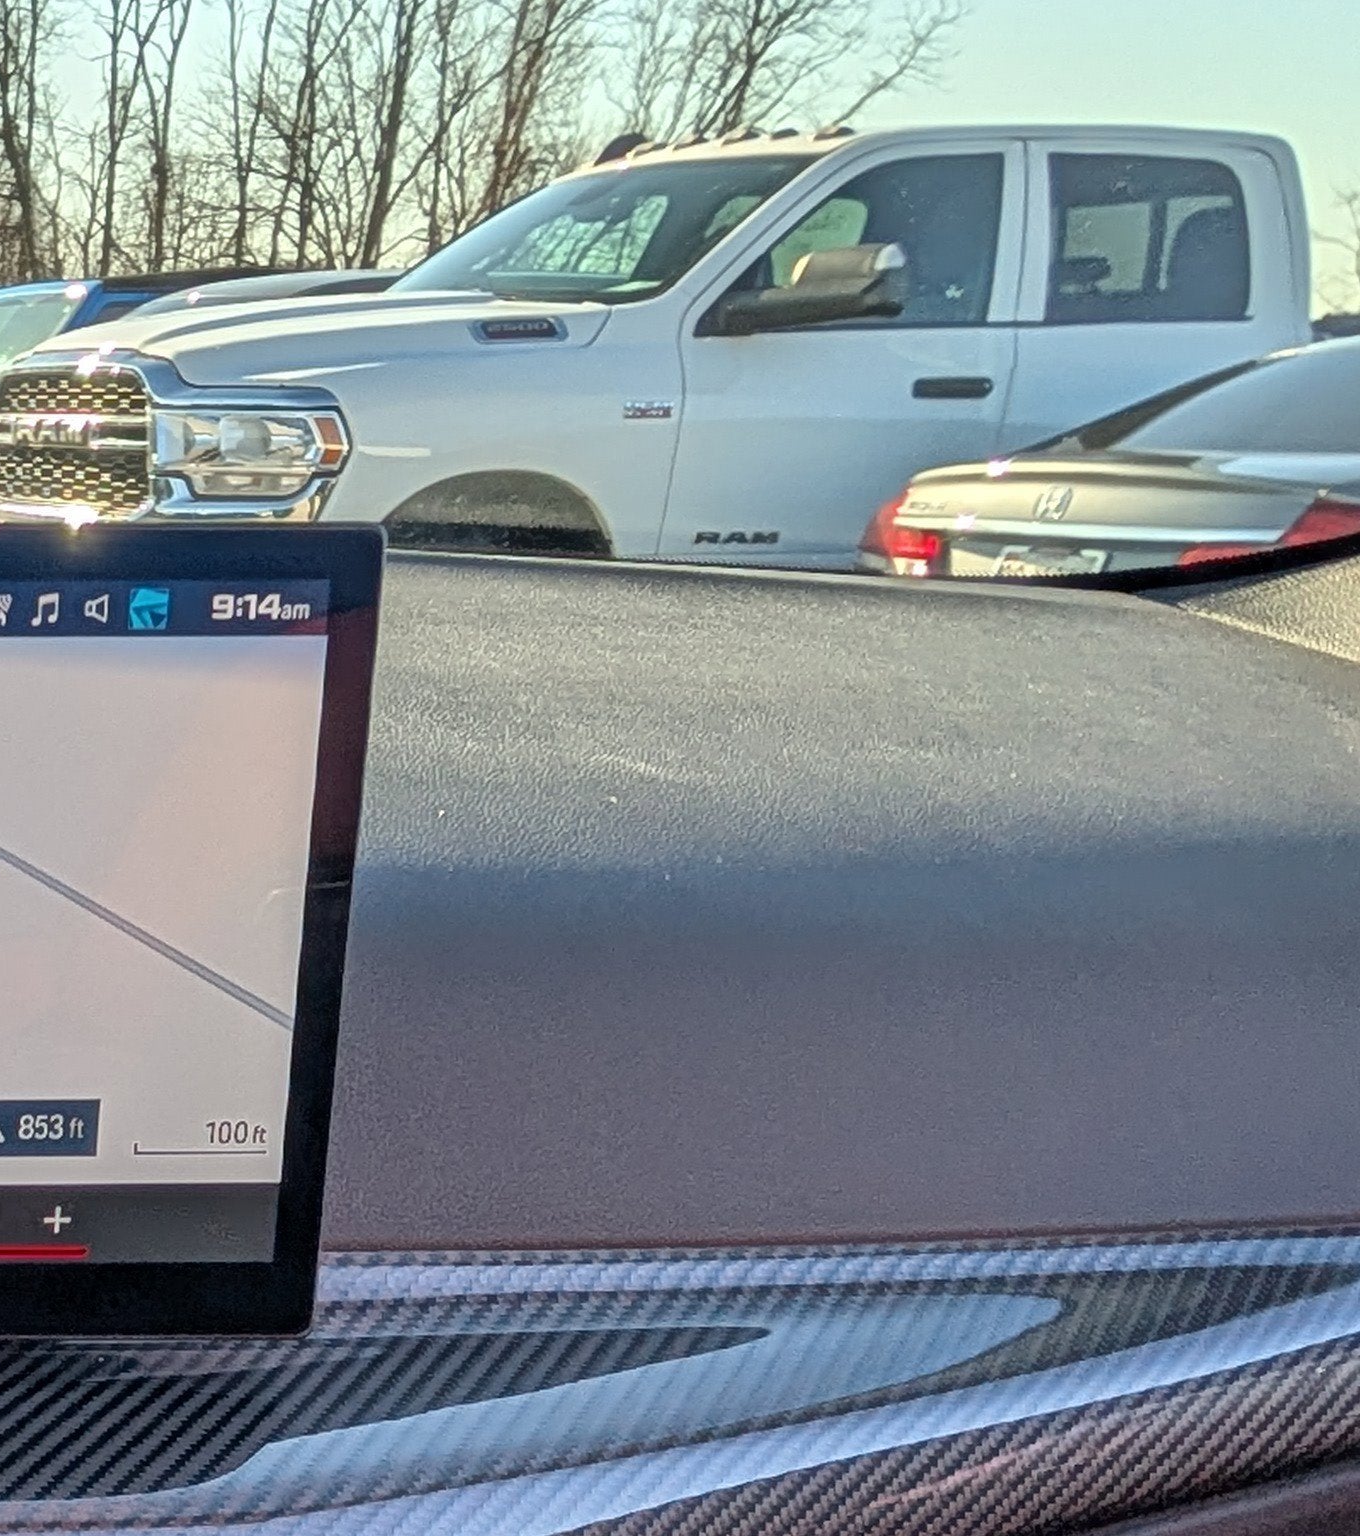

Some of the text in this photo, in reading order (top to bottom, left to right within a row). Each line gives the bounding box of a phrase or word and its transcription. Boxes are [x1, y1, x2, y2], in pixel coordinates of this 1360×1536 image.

[694, 531, 779, 544] RAM
[18, 1115, 84, 1140] 853 ft
[206, 1122, 267, 1145] 100 ft
